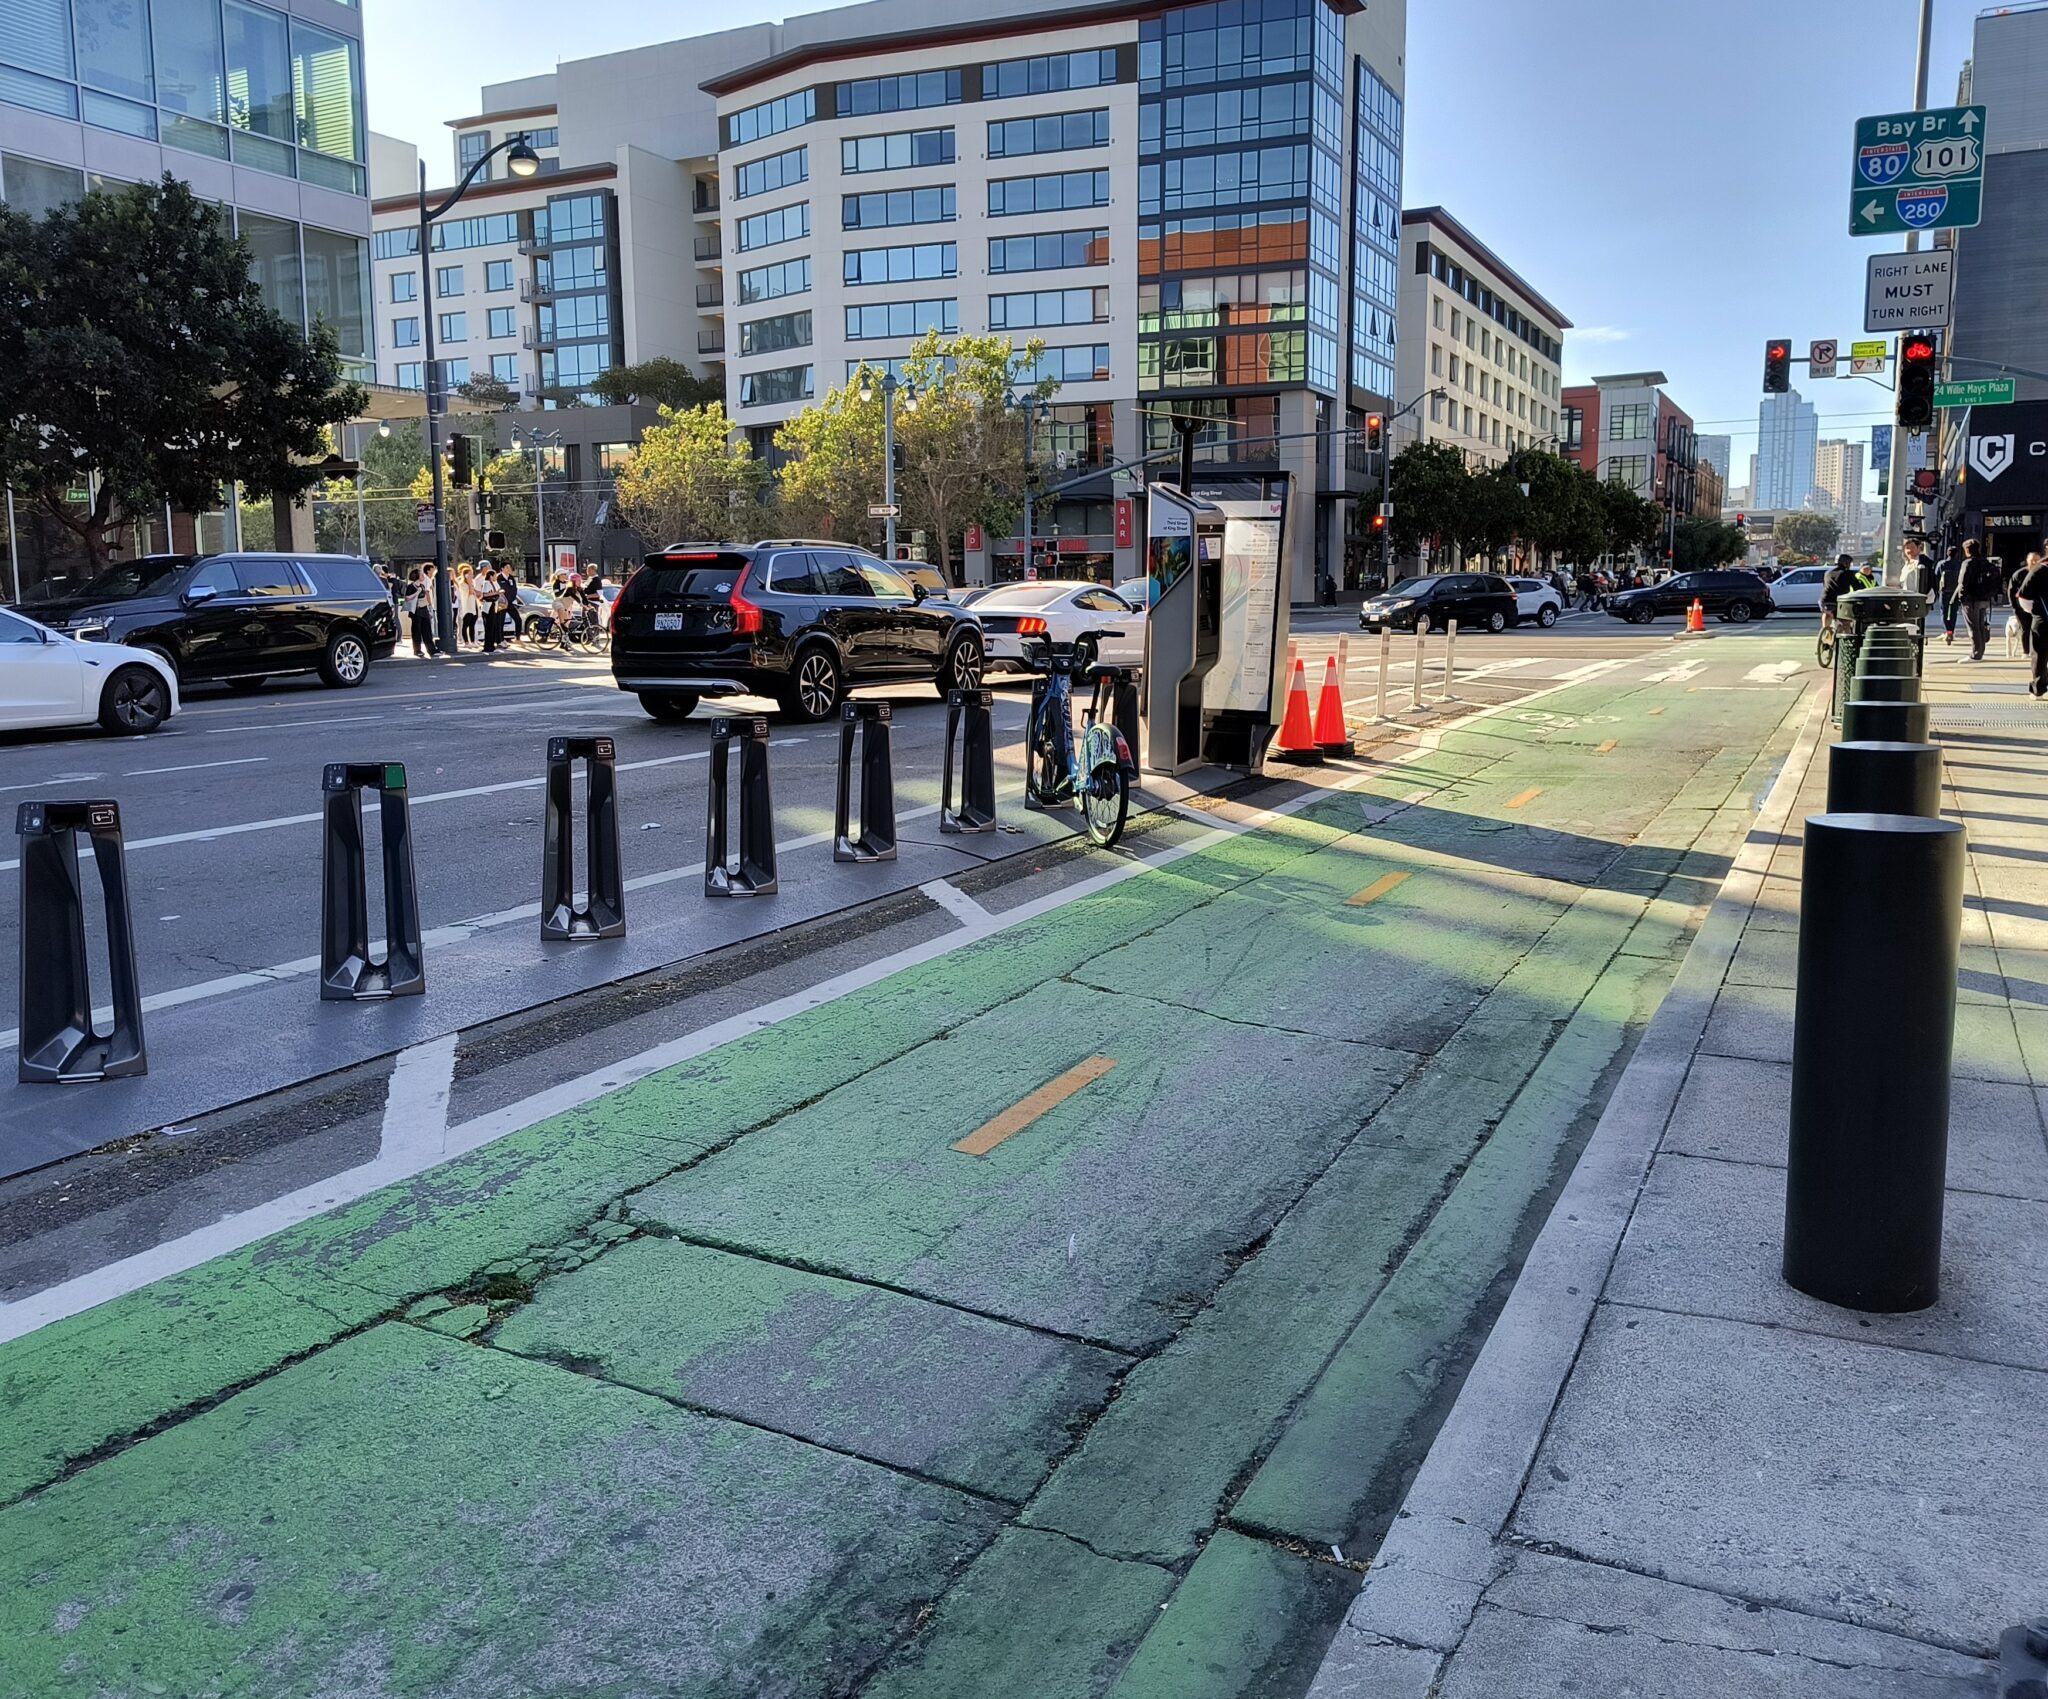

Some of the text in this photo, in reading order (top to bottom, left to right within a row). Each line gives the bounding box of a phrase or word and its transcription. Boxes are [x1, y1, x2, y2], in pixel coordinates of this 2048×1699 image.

[1877, 116, 1946, 137] Bay Br
[1866, 146, 1902, 154] INTERSTATE
[1926, 146, 1966, 169] 101
[1868, 155, 1900, 177] 80
[1904, 189, 1941, 197] INTERSTATE
[1905, 202, 1940, 219] 280
[1874, 262, 1948, 278] RIGHT LANE
[1885, 284, 1934, 299] MUST
[1872, 304, 1944, 319] TURN RIGHT
[1934, 382, 2009, 396] 24 Willie Mays Plaza
